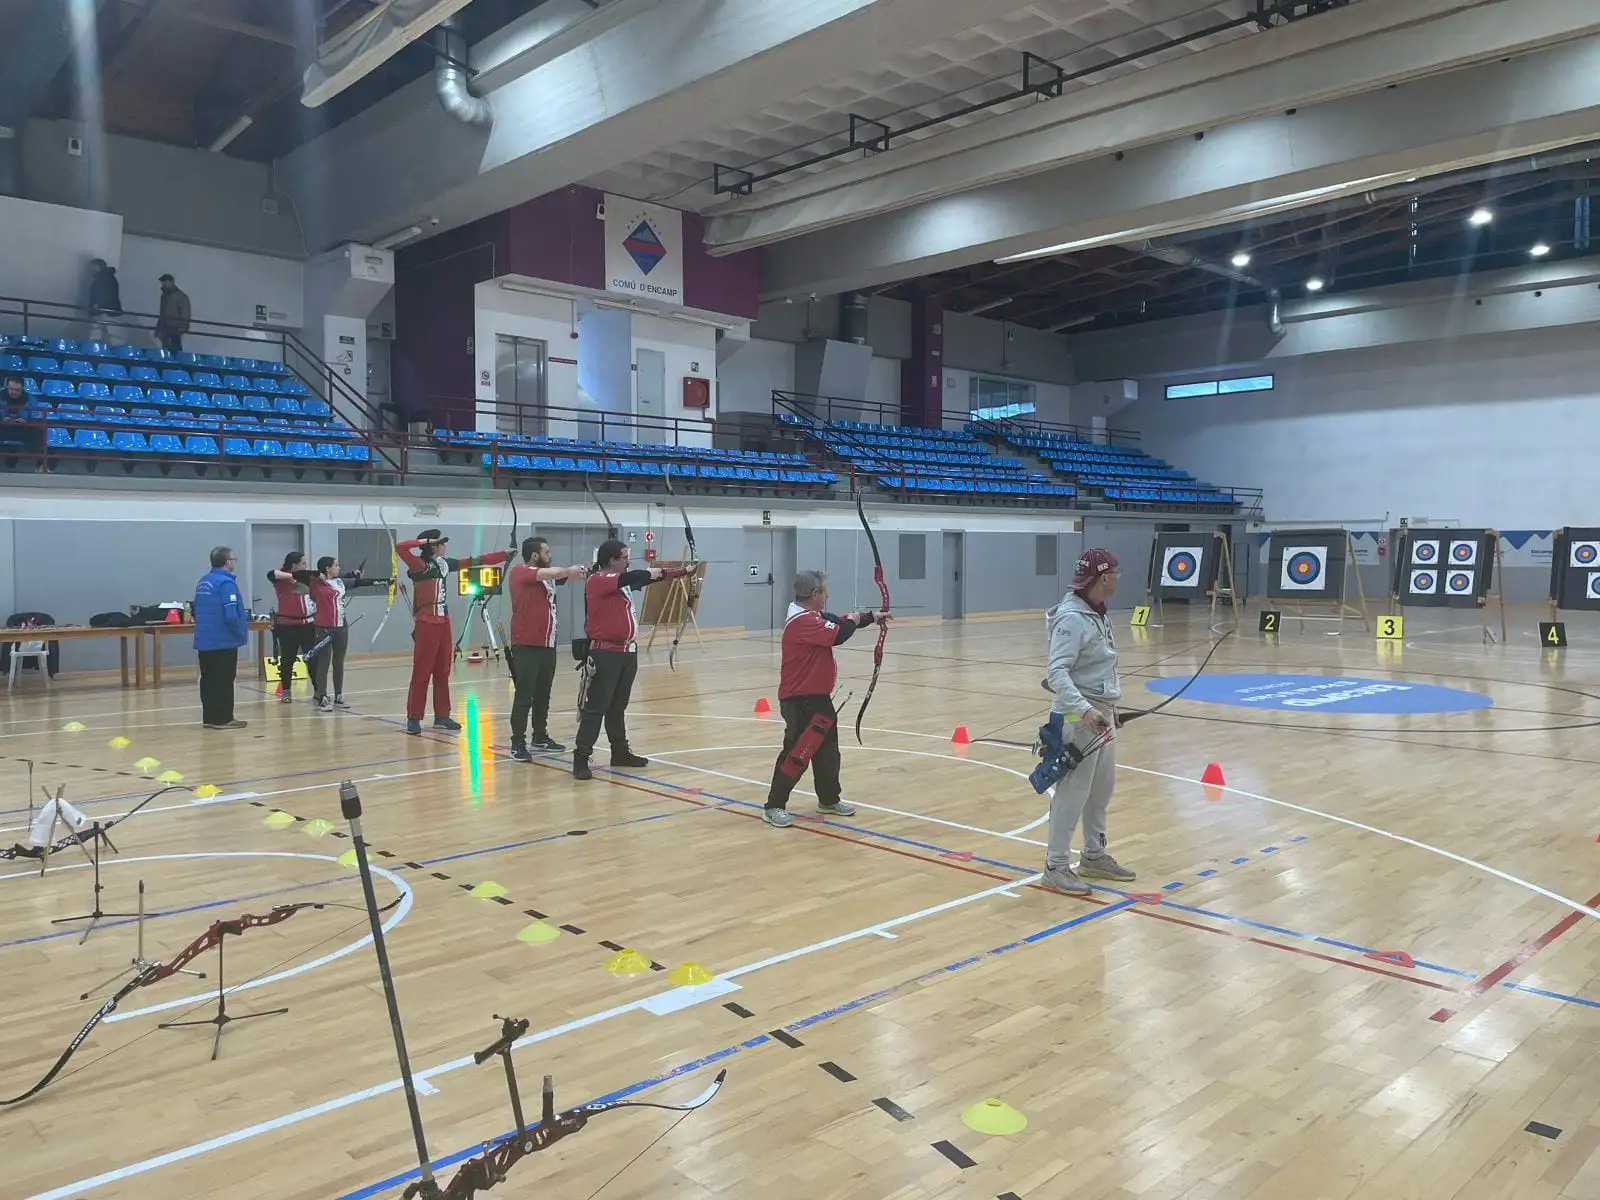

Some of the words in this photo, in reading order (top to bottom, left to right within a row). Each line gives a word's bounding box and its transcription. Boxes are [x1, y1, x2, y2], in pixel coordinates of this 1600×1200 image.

[613, 279, 636, 290] COMÚ
[640, 283, 678, 296] D'ENCAMP
[1138, 608, 1145, 623] 1
[1264, 614, 1275, 630] 2
[1383, 619, 1395, 636] 3
[1547, 625, 1559, 645] 4
